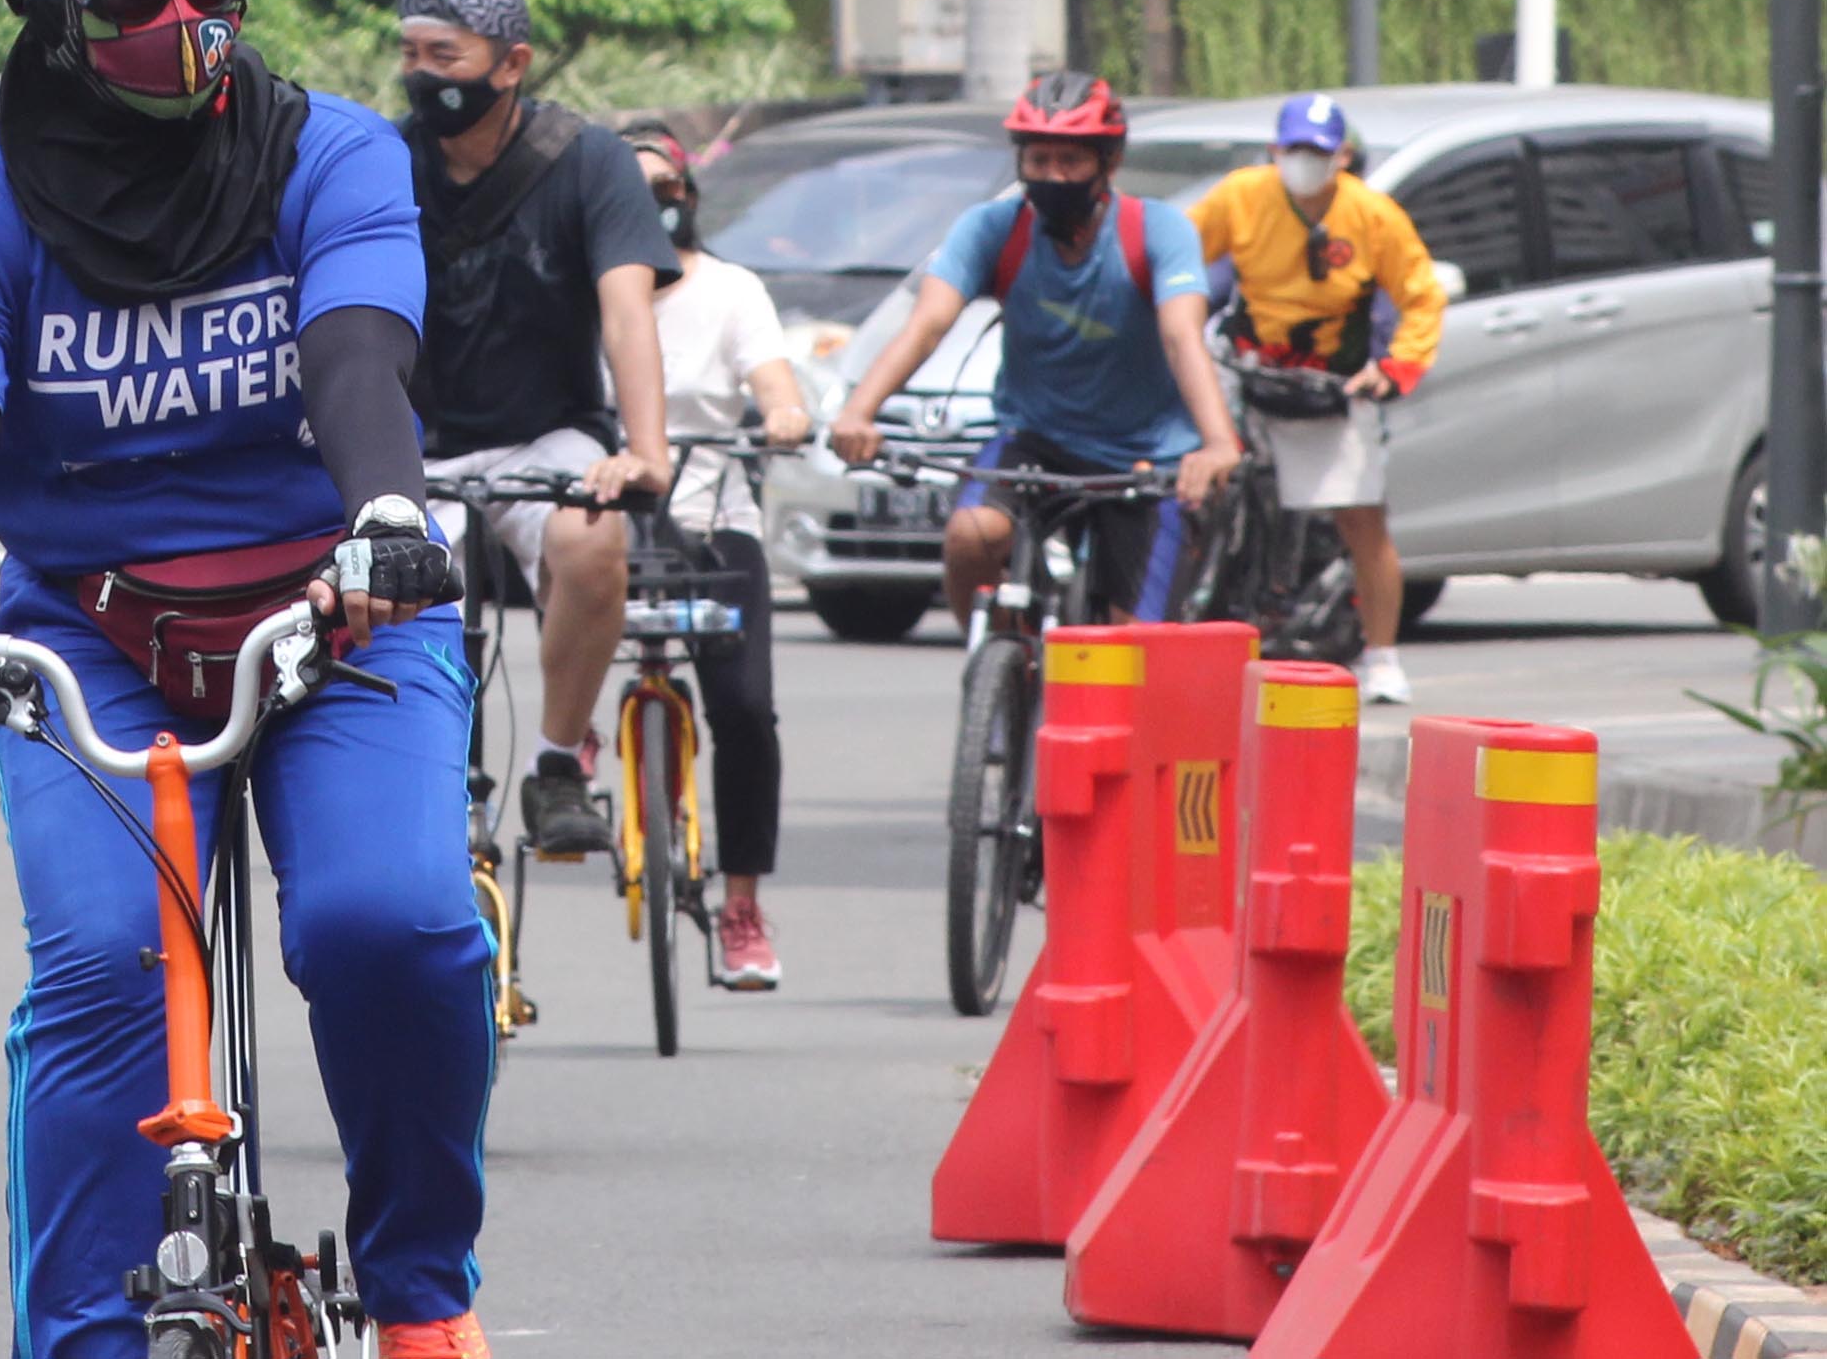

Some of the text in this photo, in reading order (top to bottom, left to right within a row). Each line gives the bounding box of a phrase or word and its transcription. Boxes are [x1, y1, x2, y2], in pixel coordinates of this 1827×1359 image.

[37, 294, 291, 372] RUN FOR
[97, 341, 301, 429] WATER
